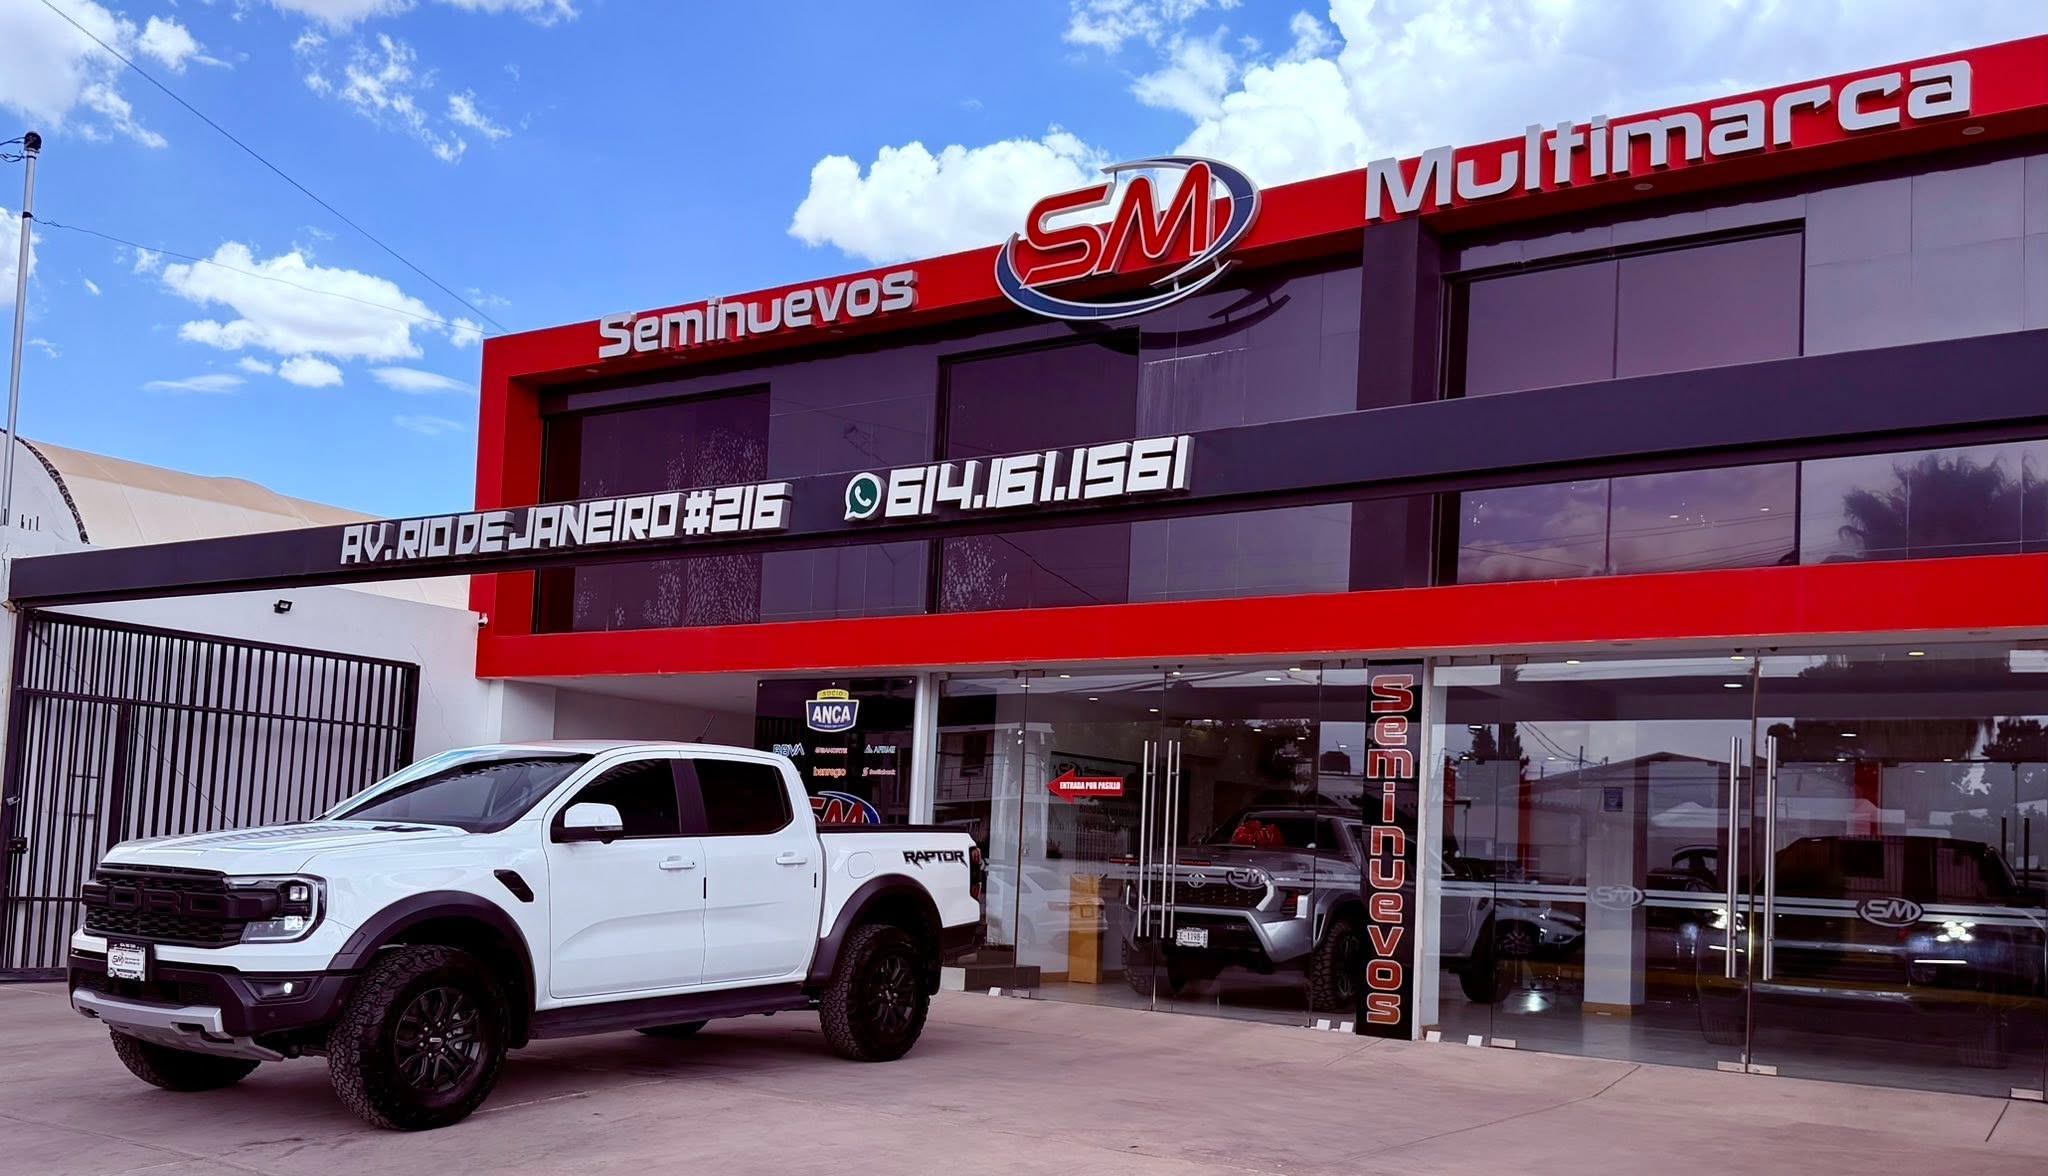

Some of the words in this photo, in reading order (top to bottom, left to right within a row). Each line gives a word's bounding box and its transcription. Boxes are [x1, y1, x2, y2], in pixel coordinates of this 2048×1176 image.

[598, 270, 918, 358] Seminuevos
[1020, 161, 1212, 290] SM
[1365, 60, 1973, 222] Multimarca
[885, 434, 1195, 518] 614.161.1561
[340, 521, 394, 565] AV.
[399, 515, 457, 559] RIO
[455, 510, 514, 555] DE
[508, 492, 687, 550] JANEIRO
[683, 482, 793, 535] #216
[812, 705, 851, 723] ANCA
[773, 742, 805, 757] BBVA
[1059, 781, 1085, 790] ENTRADA
[1085, 782, 1098, 790] POR
[1098, 782, 1121, 790] PASILLO
[1366, 673, 1414, 1025] Seminuevos
[902, 850, 968, 870] RAPTOR
[1867, 899, 1913, 920] SM
